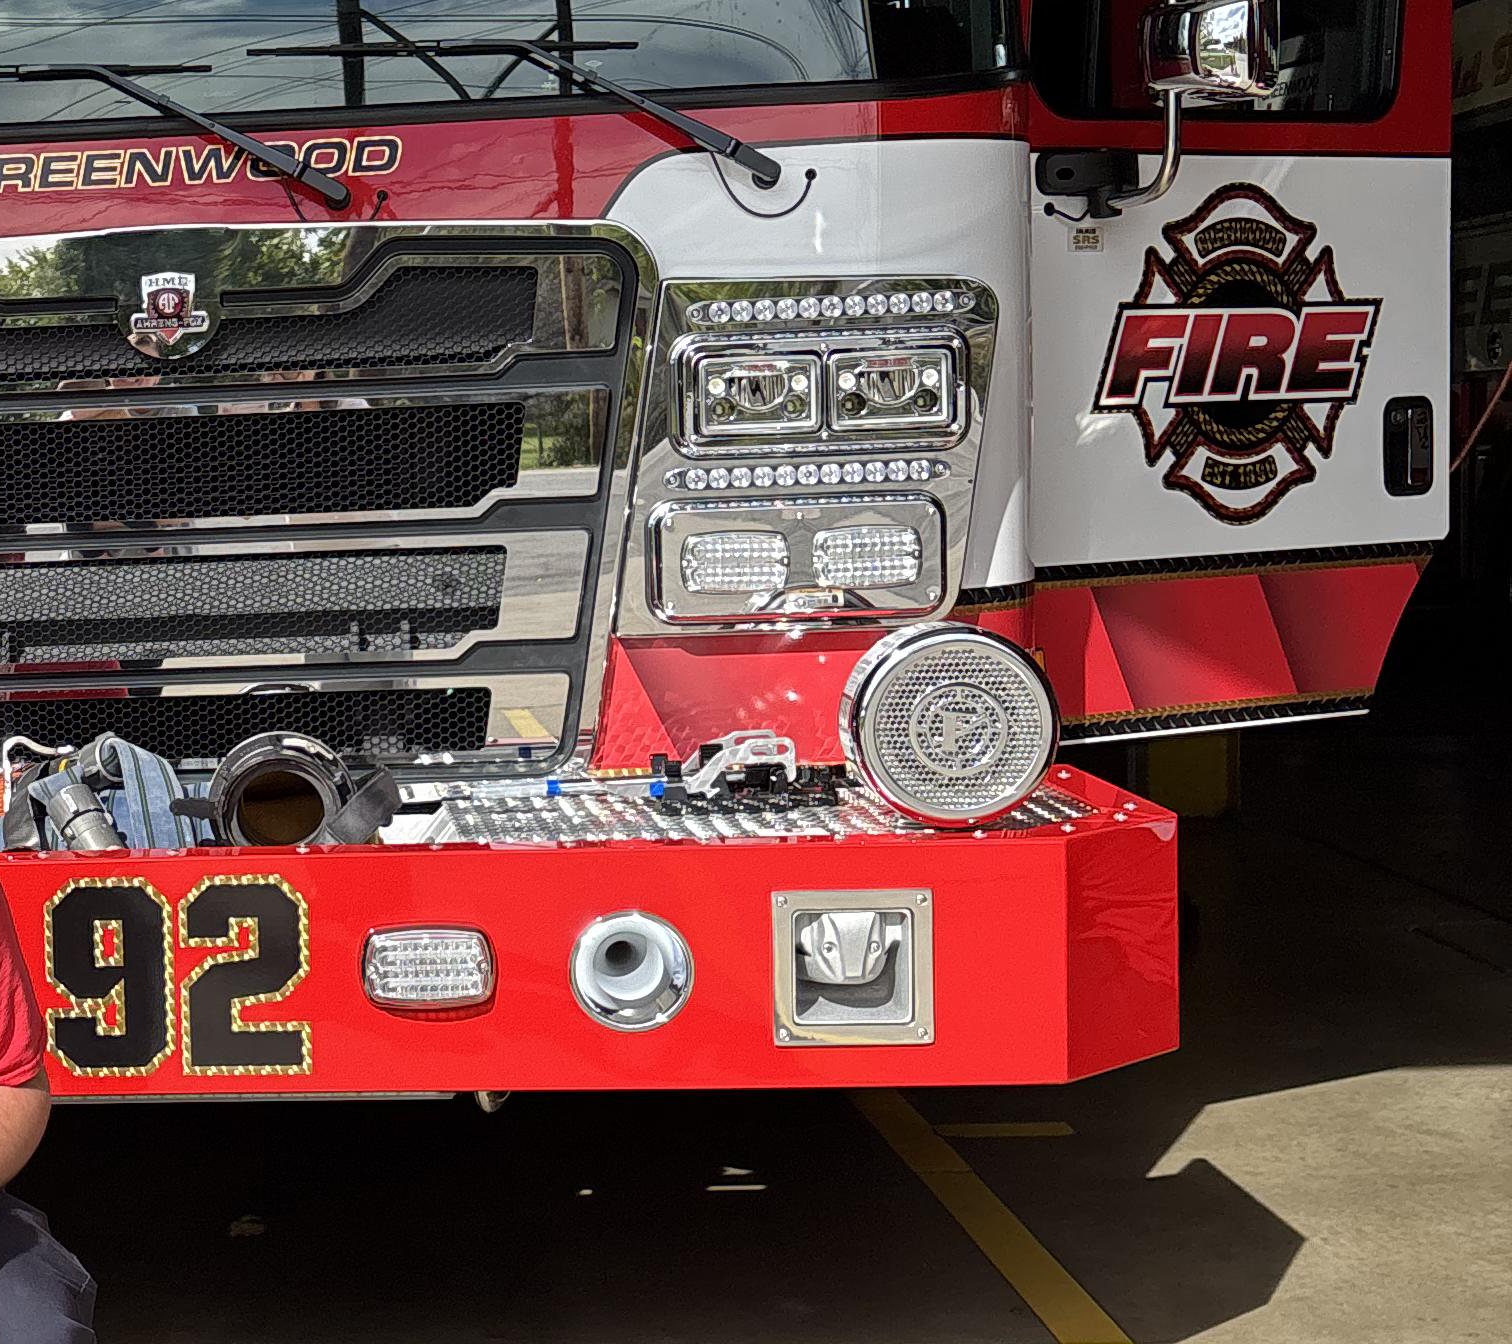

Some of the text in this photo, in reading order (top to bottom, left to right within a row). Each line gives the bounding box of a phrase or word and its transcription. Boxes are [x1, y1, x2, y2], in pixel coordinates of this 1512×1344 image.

[1073, 235, 1099, 244] SRS
[1097, 305, 1376, 408] FIRE
[44, 874, 312, 1076] 92
